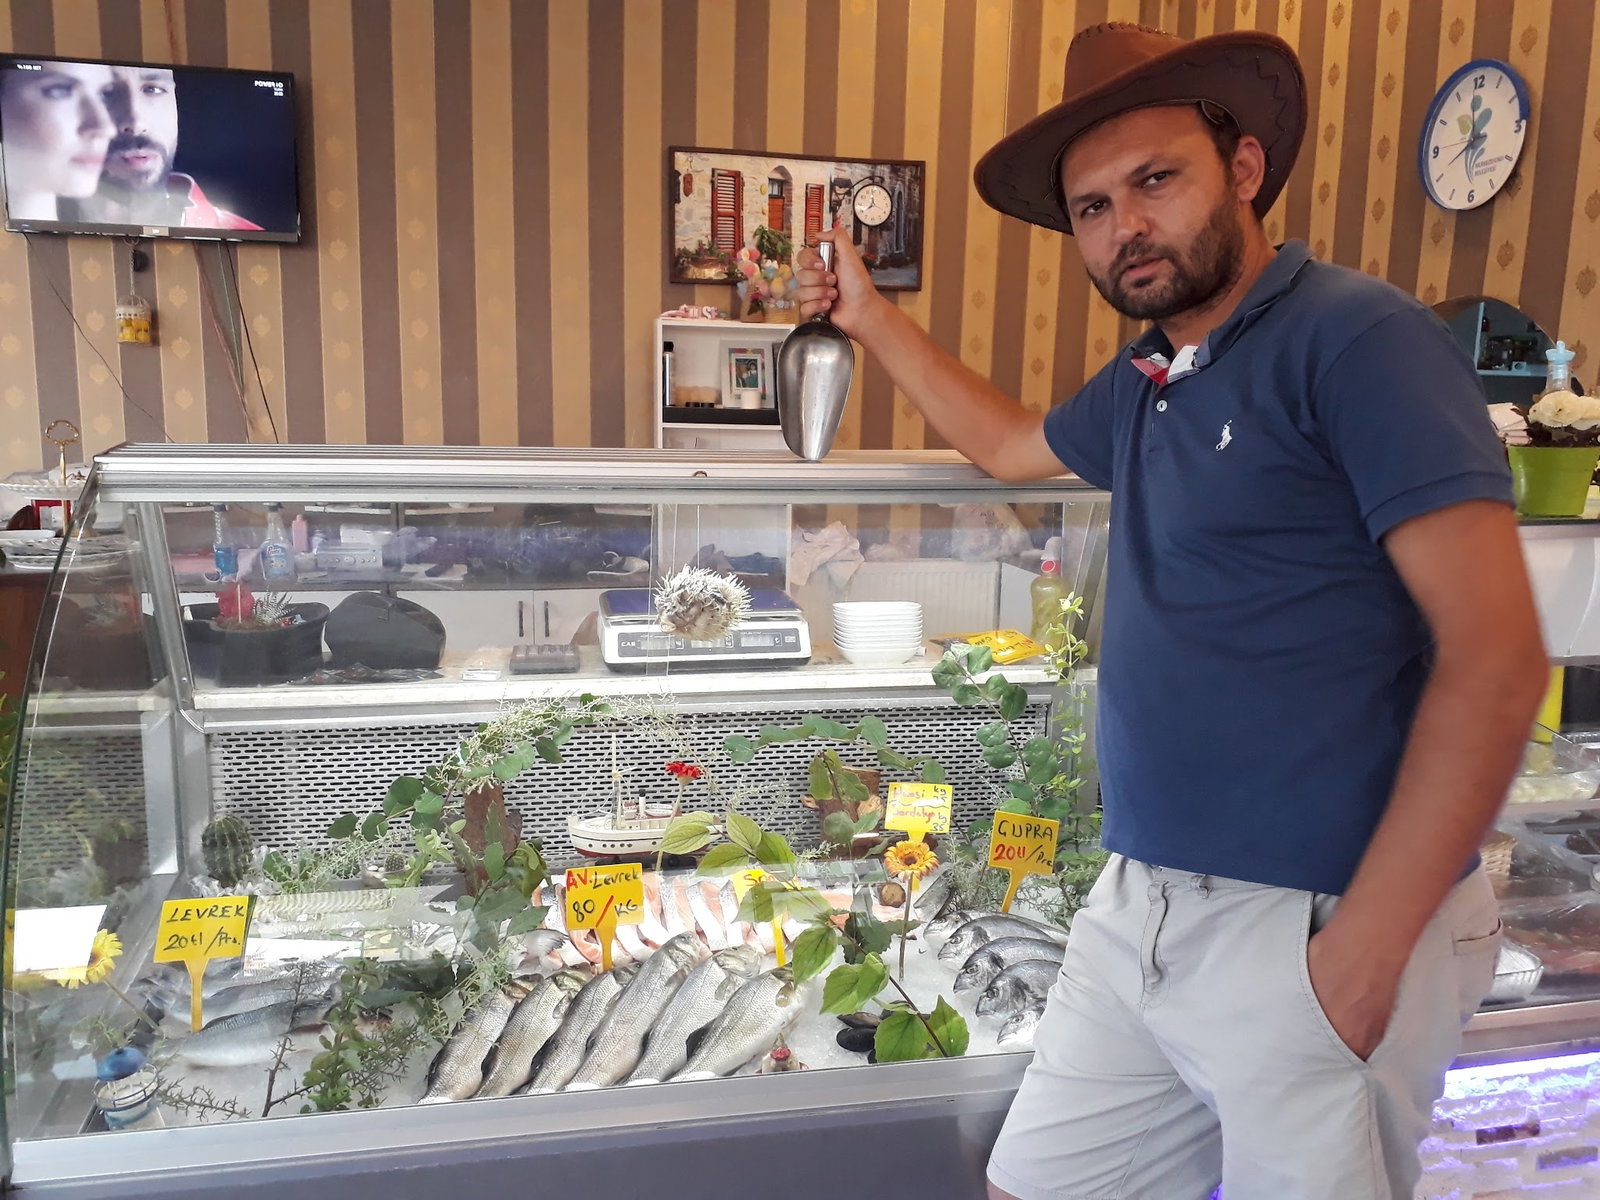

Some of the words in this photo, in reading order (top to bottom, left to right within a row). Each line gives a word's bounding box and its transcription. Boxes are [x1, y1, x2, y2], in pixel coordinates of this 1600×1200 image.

[1473, 74, 1486, 90] 12
[1432, 145, 1440, 159] 9
[1467, 189, 1475, 203] 6
[165, 904, 245, 924] LEVREK
